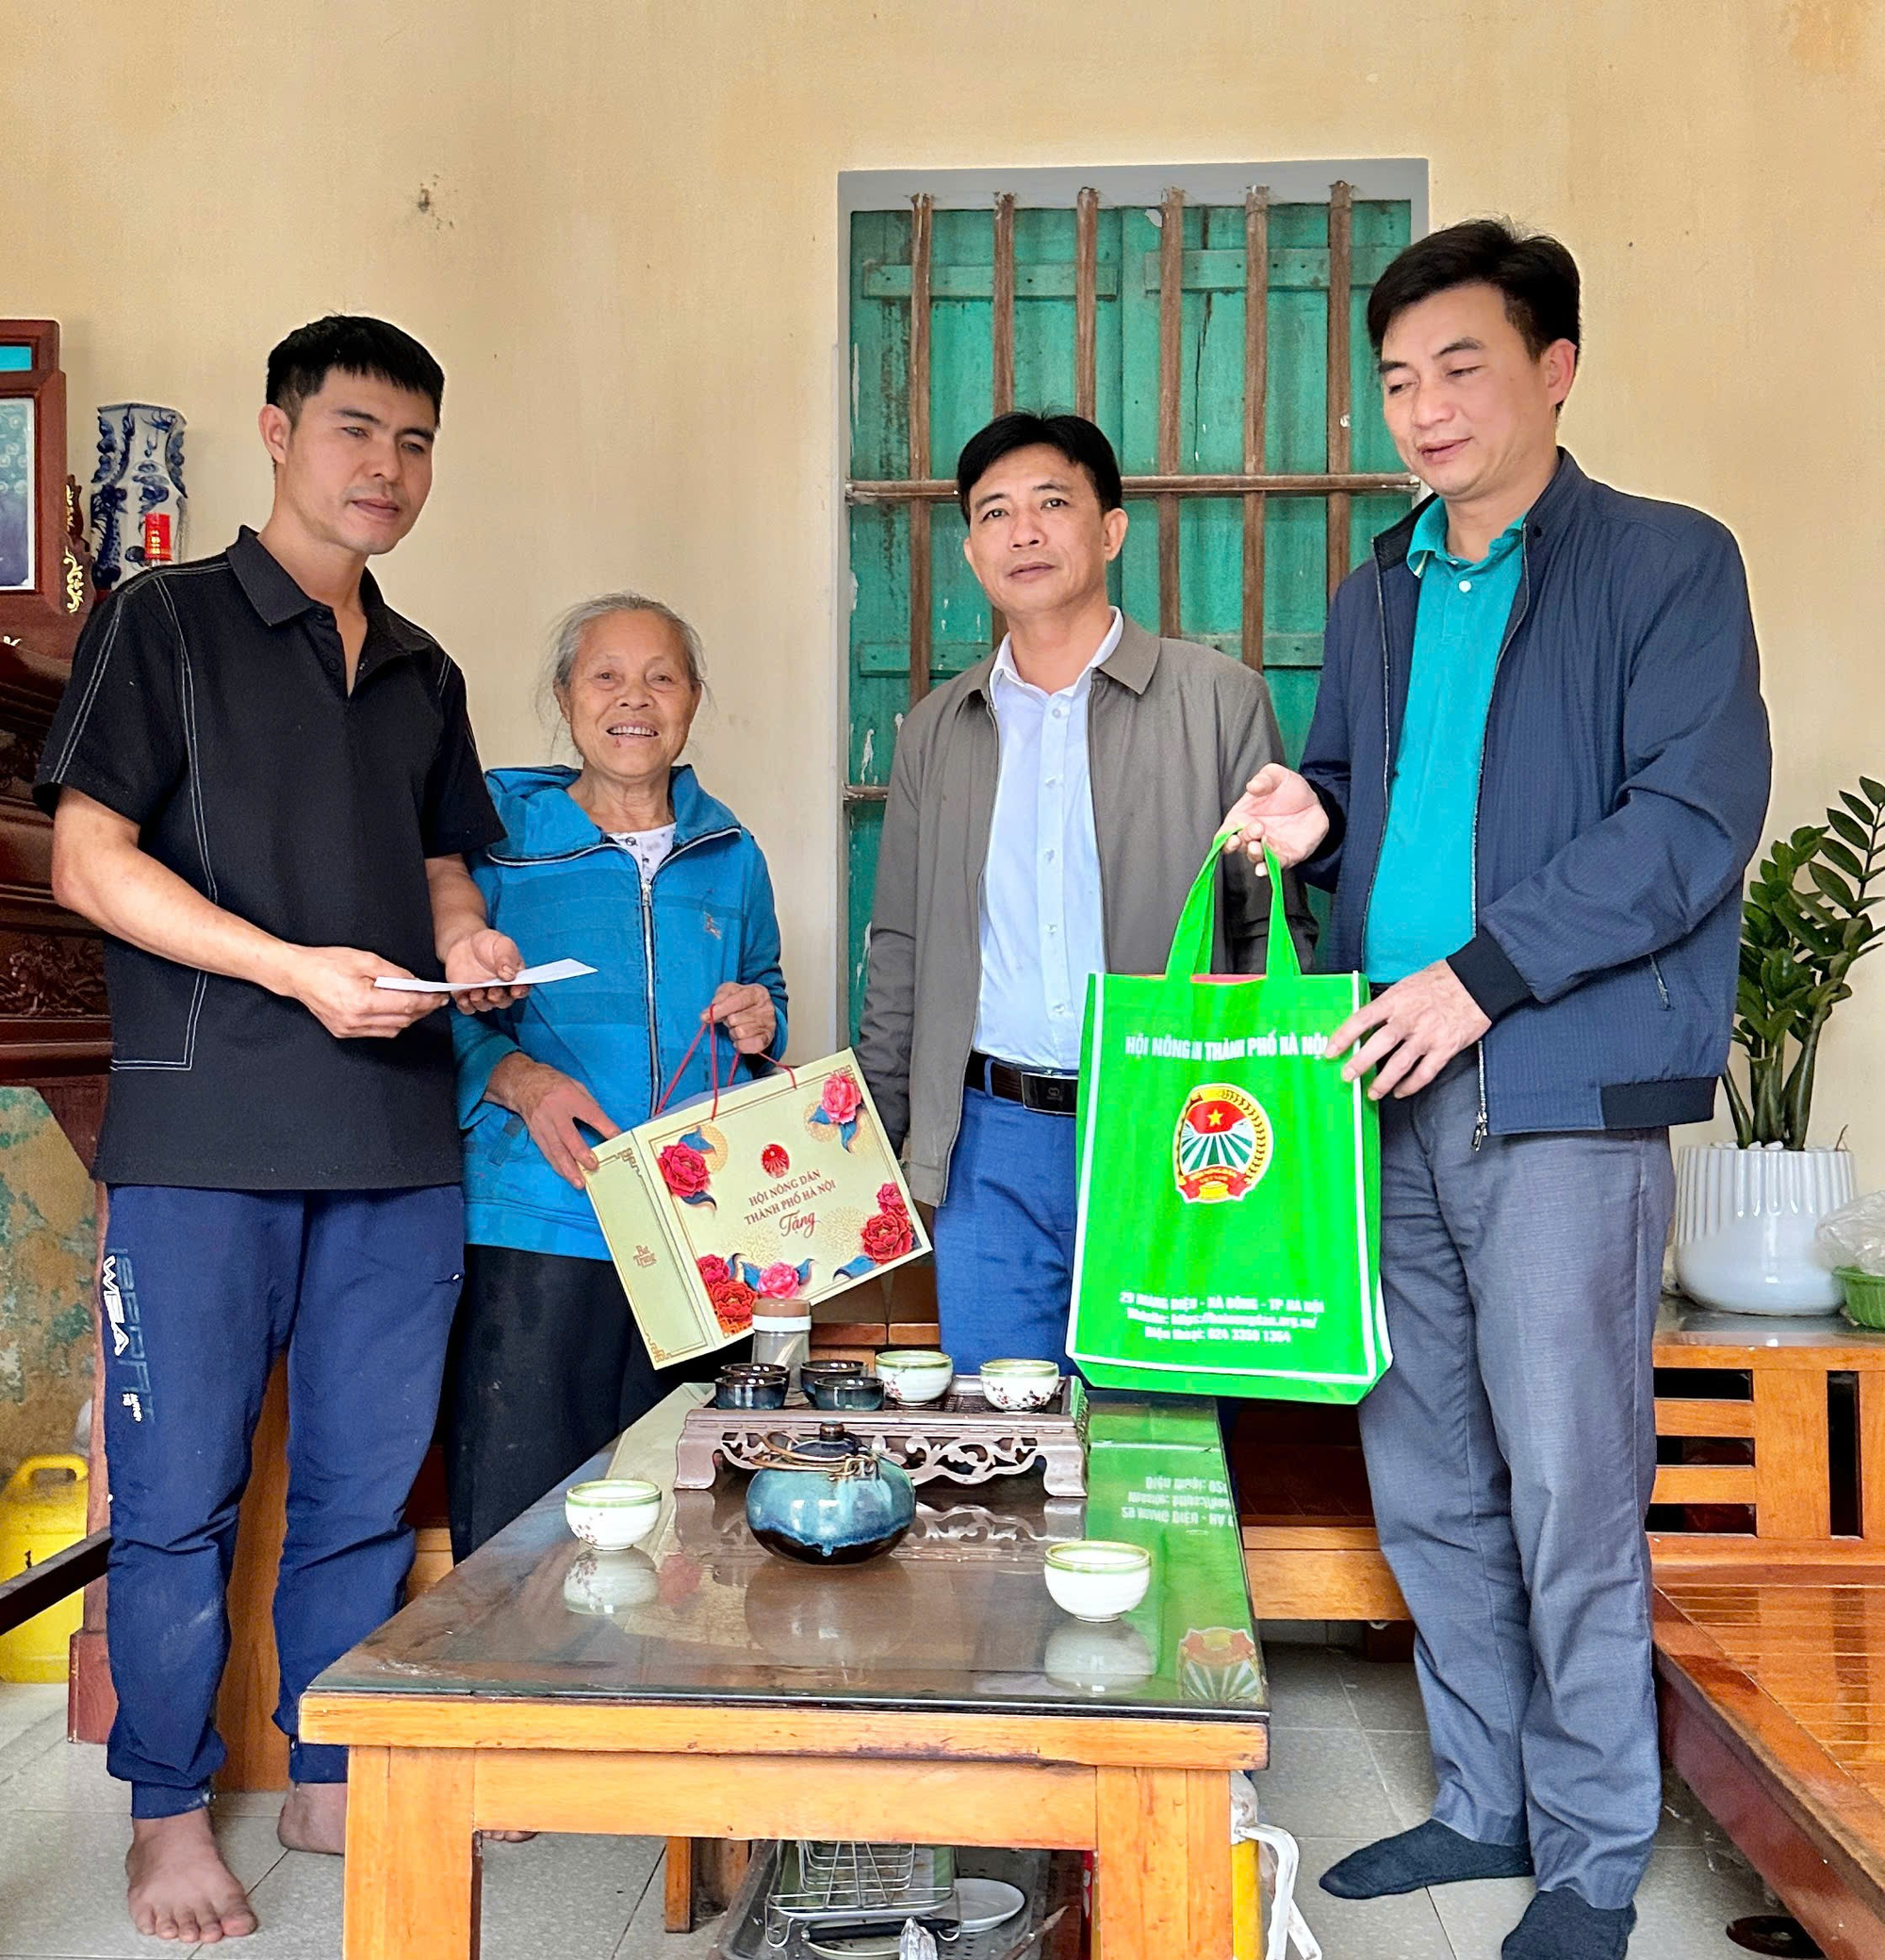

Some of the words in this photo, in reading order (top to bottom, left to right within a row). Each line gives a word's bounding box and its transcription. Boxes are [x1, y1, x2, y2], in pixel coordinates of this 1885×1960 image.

[1125, 1032, 1149, 1059] HỘI
[1152, 1034, 1191, 1059] NÔNG
[1247, 1029, 1277, 1056] PHỐ
[1279, 1032, 1299, 1055] HÀ
[744, 1203, 781, 1225] THÀNH
[780, 1191, 802, 1210] PHỐ
[802, 1186, 818, 1201] HÀ
[817, 1179, 837, 1194] NỘI
[748, 1191, 769, 1207] HỘI
[769, 1178, 799, 1198] NÔNG
[798, 1169, 821, 1185] DÂN
[779, 1210, 818, 1239] Tặng
